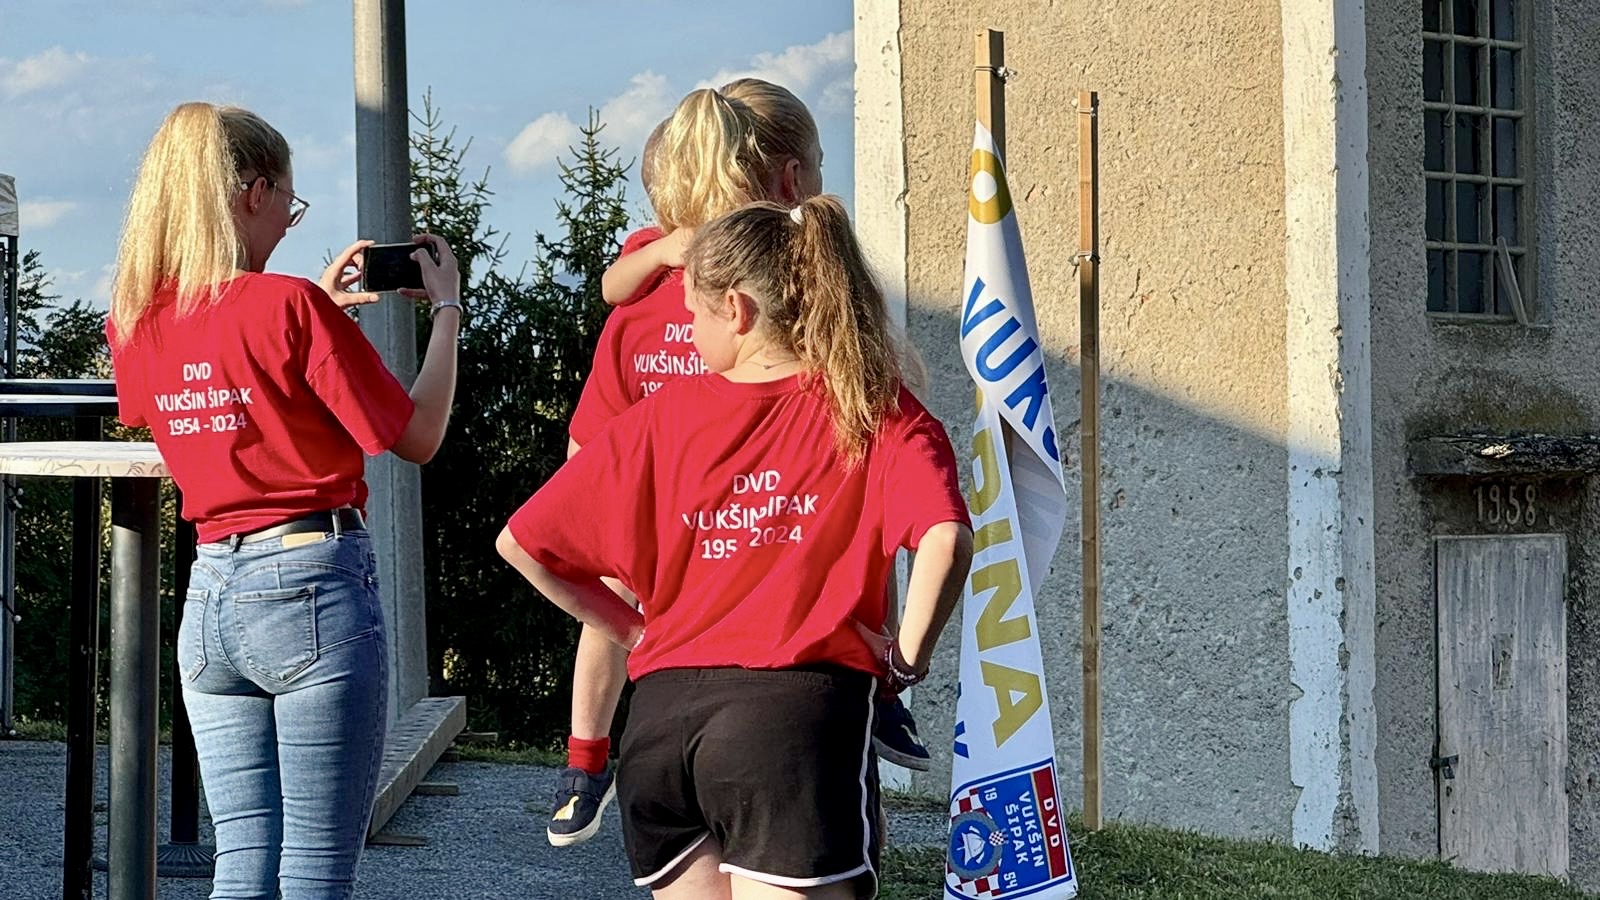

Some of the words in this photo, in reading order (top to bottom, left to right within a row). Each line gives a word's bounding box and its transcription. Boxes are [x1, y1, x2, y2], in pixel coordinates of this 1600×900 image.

[664, 323, 694, 343] DVD
[183, 362, 212, 382] DVD
[634, 350, 684, 375] VUKŠIN
[154, 388, 206, 412] VUKŠIN
[207, 386, 254, 408] ŠIPAK
[733, 470, 781, 494] DVD
[757, 494, 819, 522] IPAK
[749, 525, 803, 547] 2024
[969, 384, 1044, 749] DINA
[984, 787, 998, 801] 19
[1005, 803, 1029, 864] ŠIPAK
[1019, 791, 1045, 868] VUKŠIN
[1043, 797, 1060, 847] DVD
[1003, 872, 1018, 889] 54
